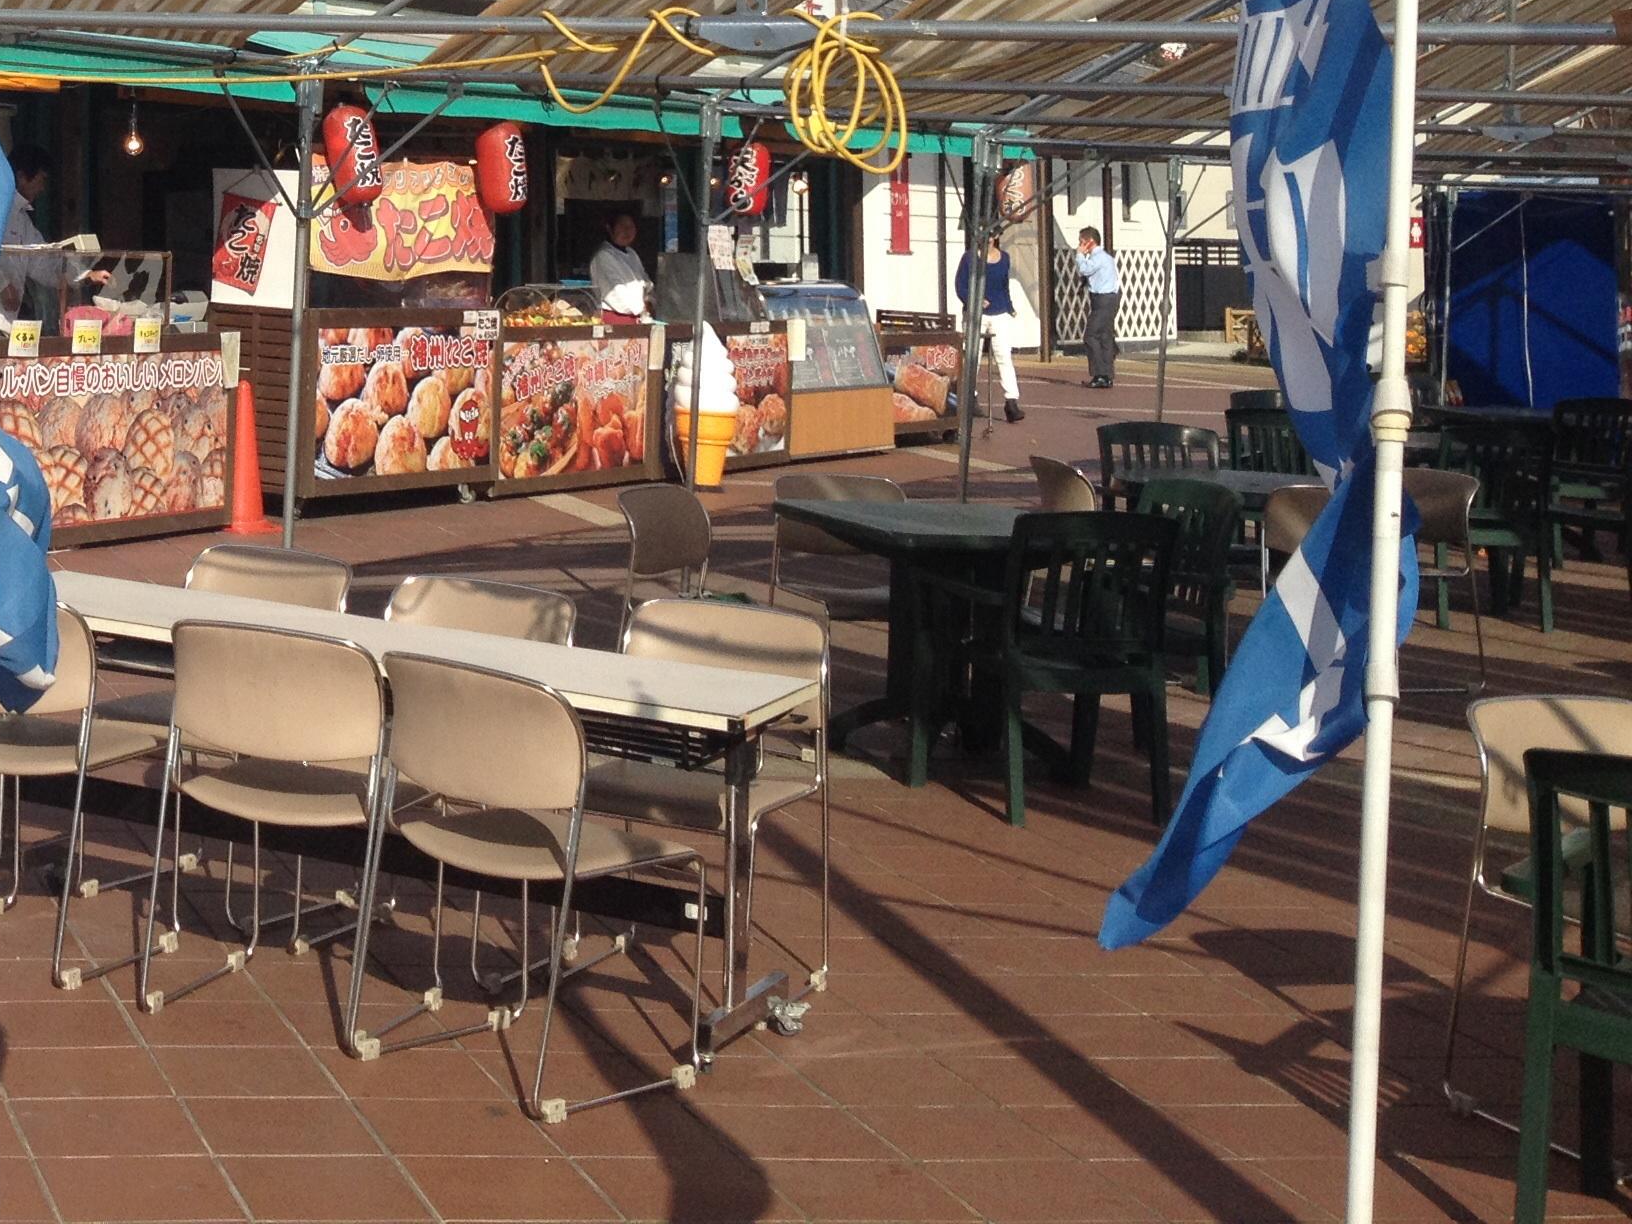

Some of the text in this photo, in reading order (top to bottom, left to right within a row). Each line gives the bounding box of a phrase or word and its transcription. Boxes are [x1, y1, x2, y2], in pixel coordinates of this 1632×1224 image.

[344, 116, 382, 188] たこ焼
[505, 134, 529, 202] たこ焼
[226, 203, 261, 284] たこ焼
